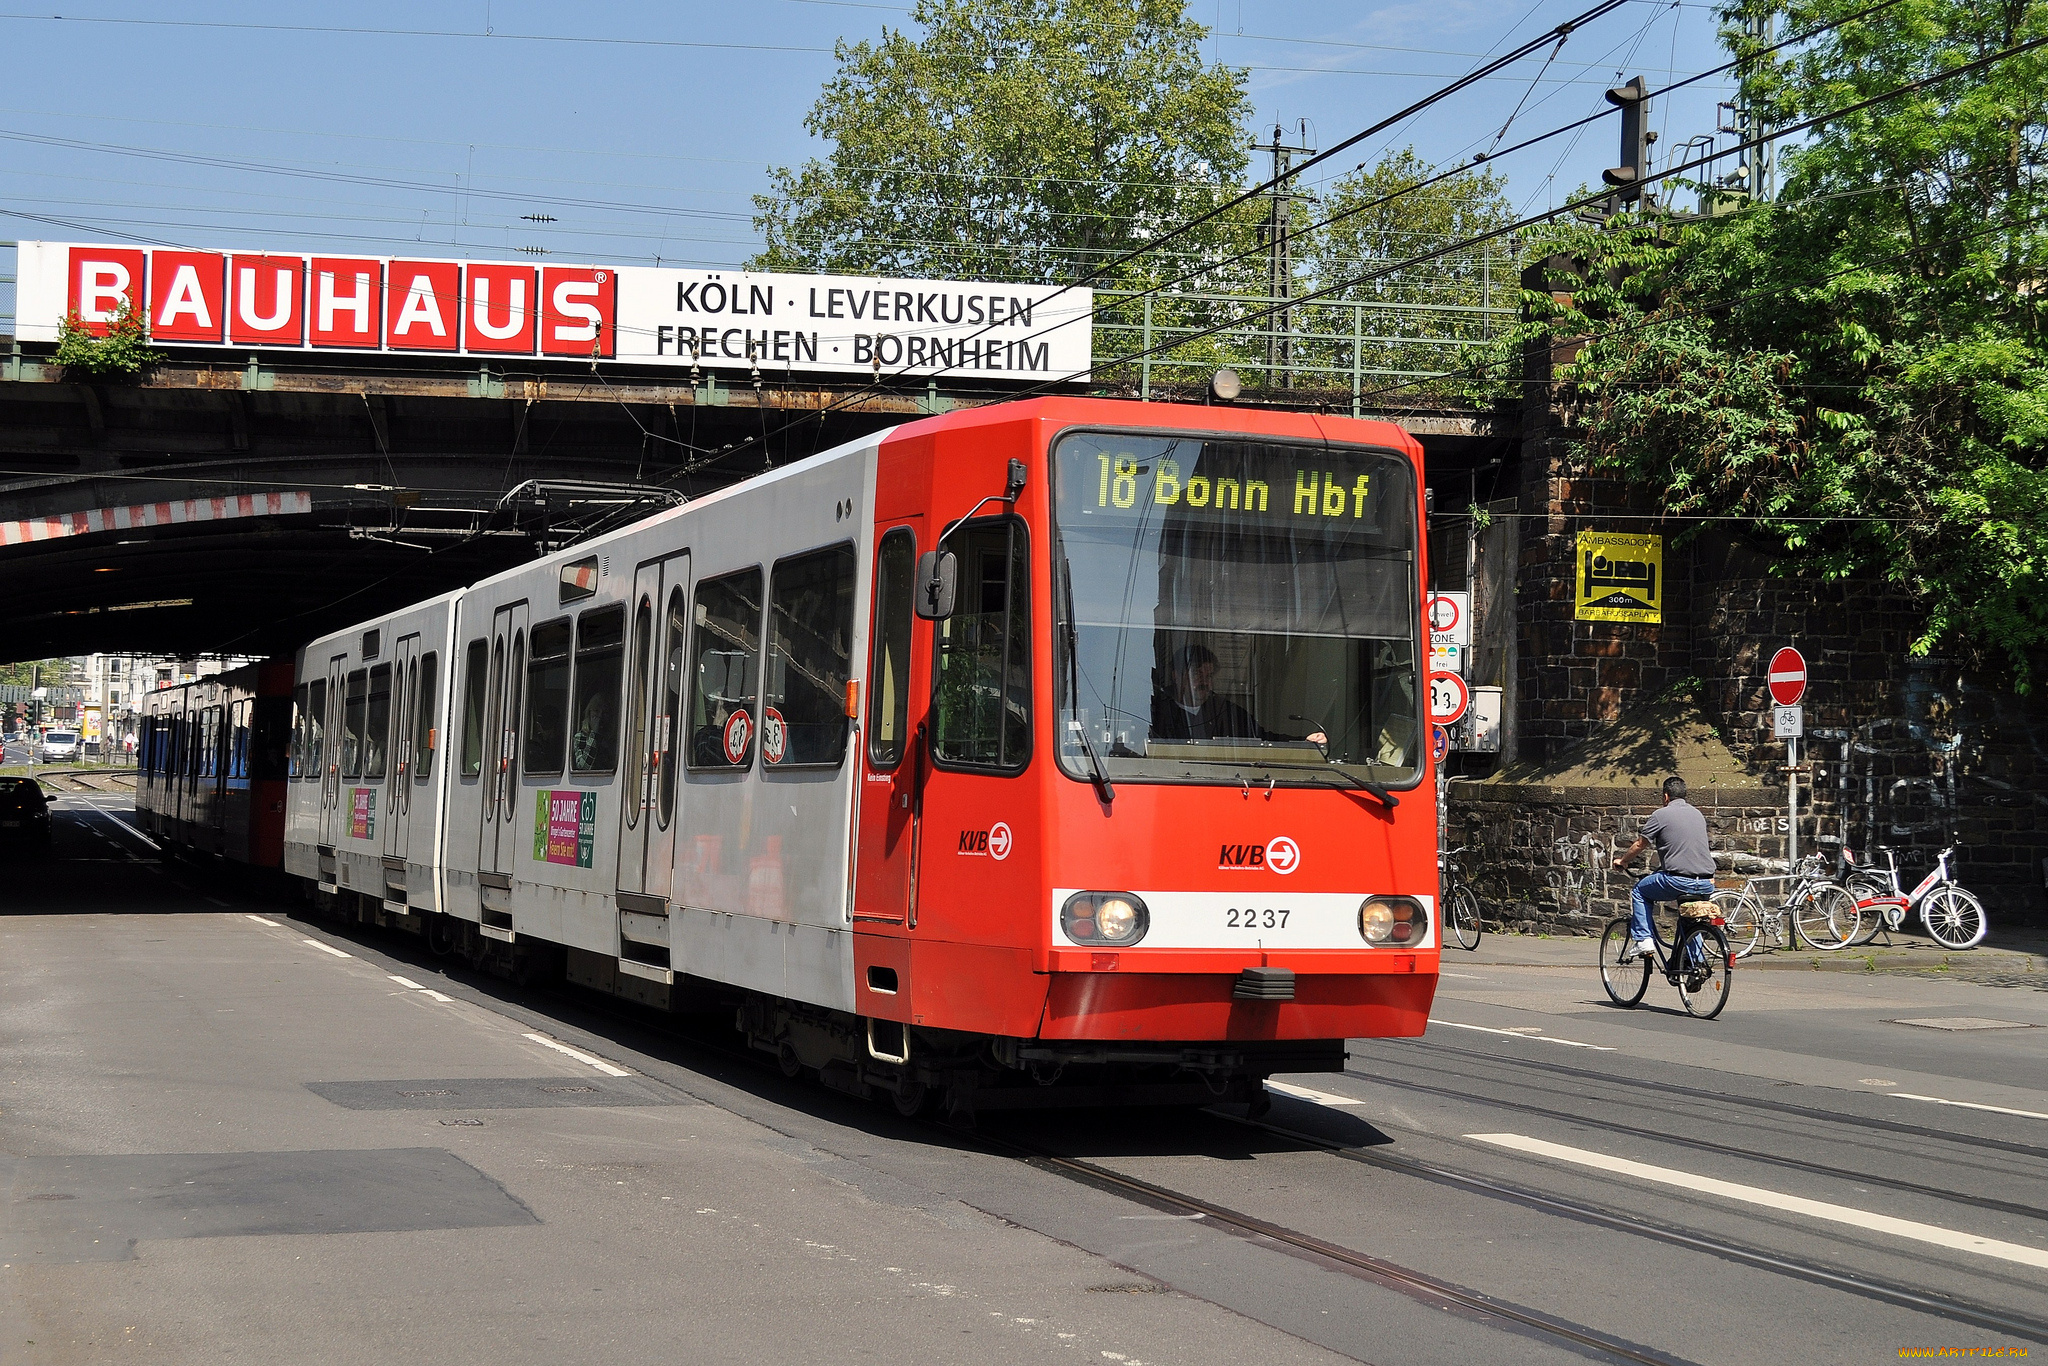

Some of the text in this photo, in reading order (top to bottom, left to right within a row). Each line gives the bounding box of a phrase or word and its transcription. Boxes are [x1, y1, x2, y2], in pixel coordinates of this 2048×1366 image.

[81, 260, 601, 341] BAUHAUS
[676, 275, 1032, 327] KÖLN LEVERKUSEN
[657, 325, 1049, 372] FRECHEN BORNHEIM
[1098, 451, 1370, 518] 18 Bonn Hbf
[1430, 634, 1455, 642] ZONE
[552, 800, 577, 822] 50 JAHRE
[958, 830, 988, 851] KVB
[1219, 845, 1265, 866] KVB
[1226, 908, 1291, 929] 2237
